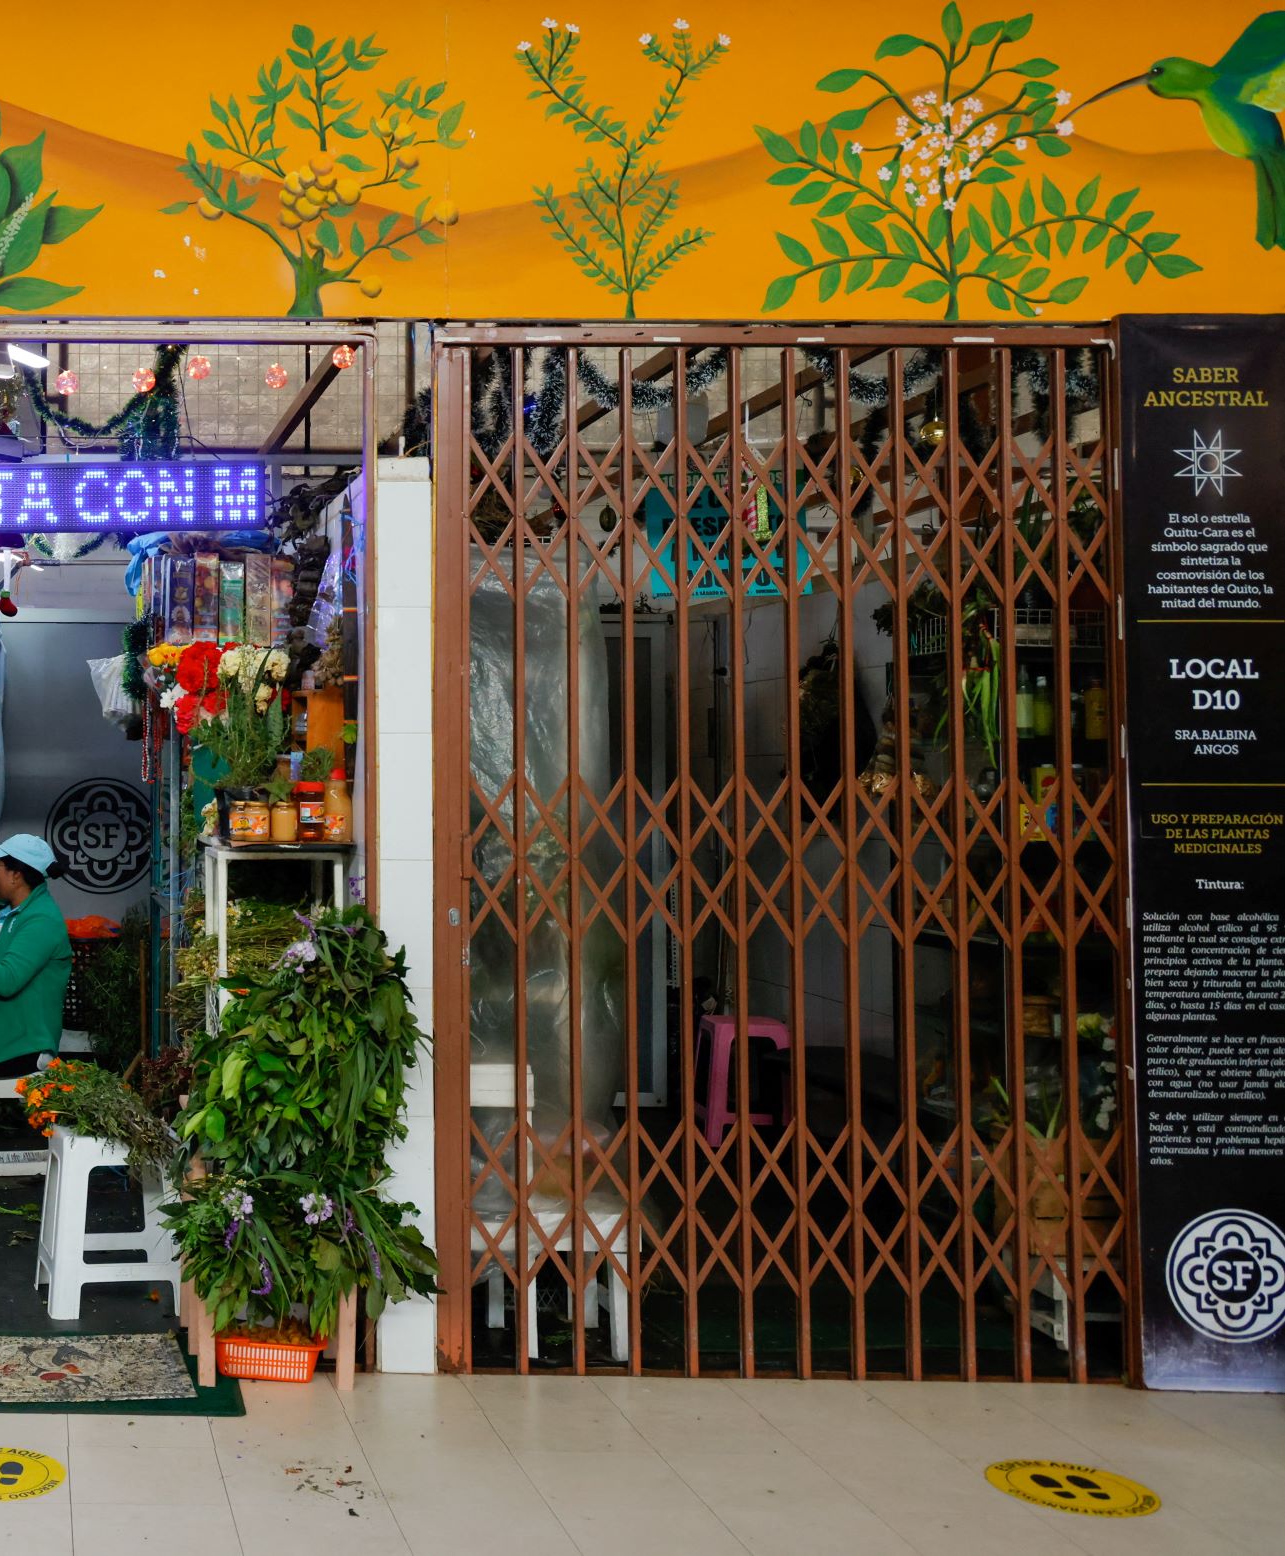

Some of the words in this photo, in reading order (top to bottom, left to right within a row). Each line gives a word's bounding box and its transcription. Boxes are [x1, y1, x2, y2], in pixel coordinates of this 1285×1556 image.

[1172, 367, 1240, 384] SABER
[1143, 390, 1269, 407] ANCESTRAL
[74, 468, 194, 523] CON
[214, 467, 257, 521] M
[1168, 513, 1180, 524] El
[1181, 513, 1199, 524] sol
[1200, 515, 1209, 524] o
[1210, 513, 1251, 524] estrella
[1163, 527, 1230, 538] Quitu-Cara
[1231, 529, 1244, 538] es
[1245, 527, 1256, 538] el
[1151, 541, 1199, 552] símbolo
[1200, 541, 1246, 554] sagrado
[1246, 543, 1268, 554] que
[1180, 555, 1230, 566] sintetiza
[1230, 555, 1242, 566] la
[1169, 658, 1260, 679] LOCAL
[1192, 689, 1241, 711] D10
[1174, 729, 1257, 741] SRA.BALBINA
[1193, 744, 1239, 755] ANGOS
[1150, 813, 1179, 825] USO
[1180, 813, 1190, 825] Y
[1191, 813, 1284, 825] PREPARACIÓN
[83, 822, 120, 849] SF
[1165, 828, 1182, 840] DE
[1184, 828, 1209, 840] LAS
[1211, 828, 1270, 840] PLANTAS
[1173, 843, 1263, 854] MEDICINALES
[1195, 878, 1245, 890] Tintura:
[1145, 1011, 1181, 1022] algunas
[1181, 1011, 1218, 1022] plantas.
[1211, 1260, 1255, 1292] SF
[7, 1447, 47, 1460] AQUI
[9, 1479, 60, 1500] MERCADO
